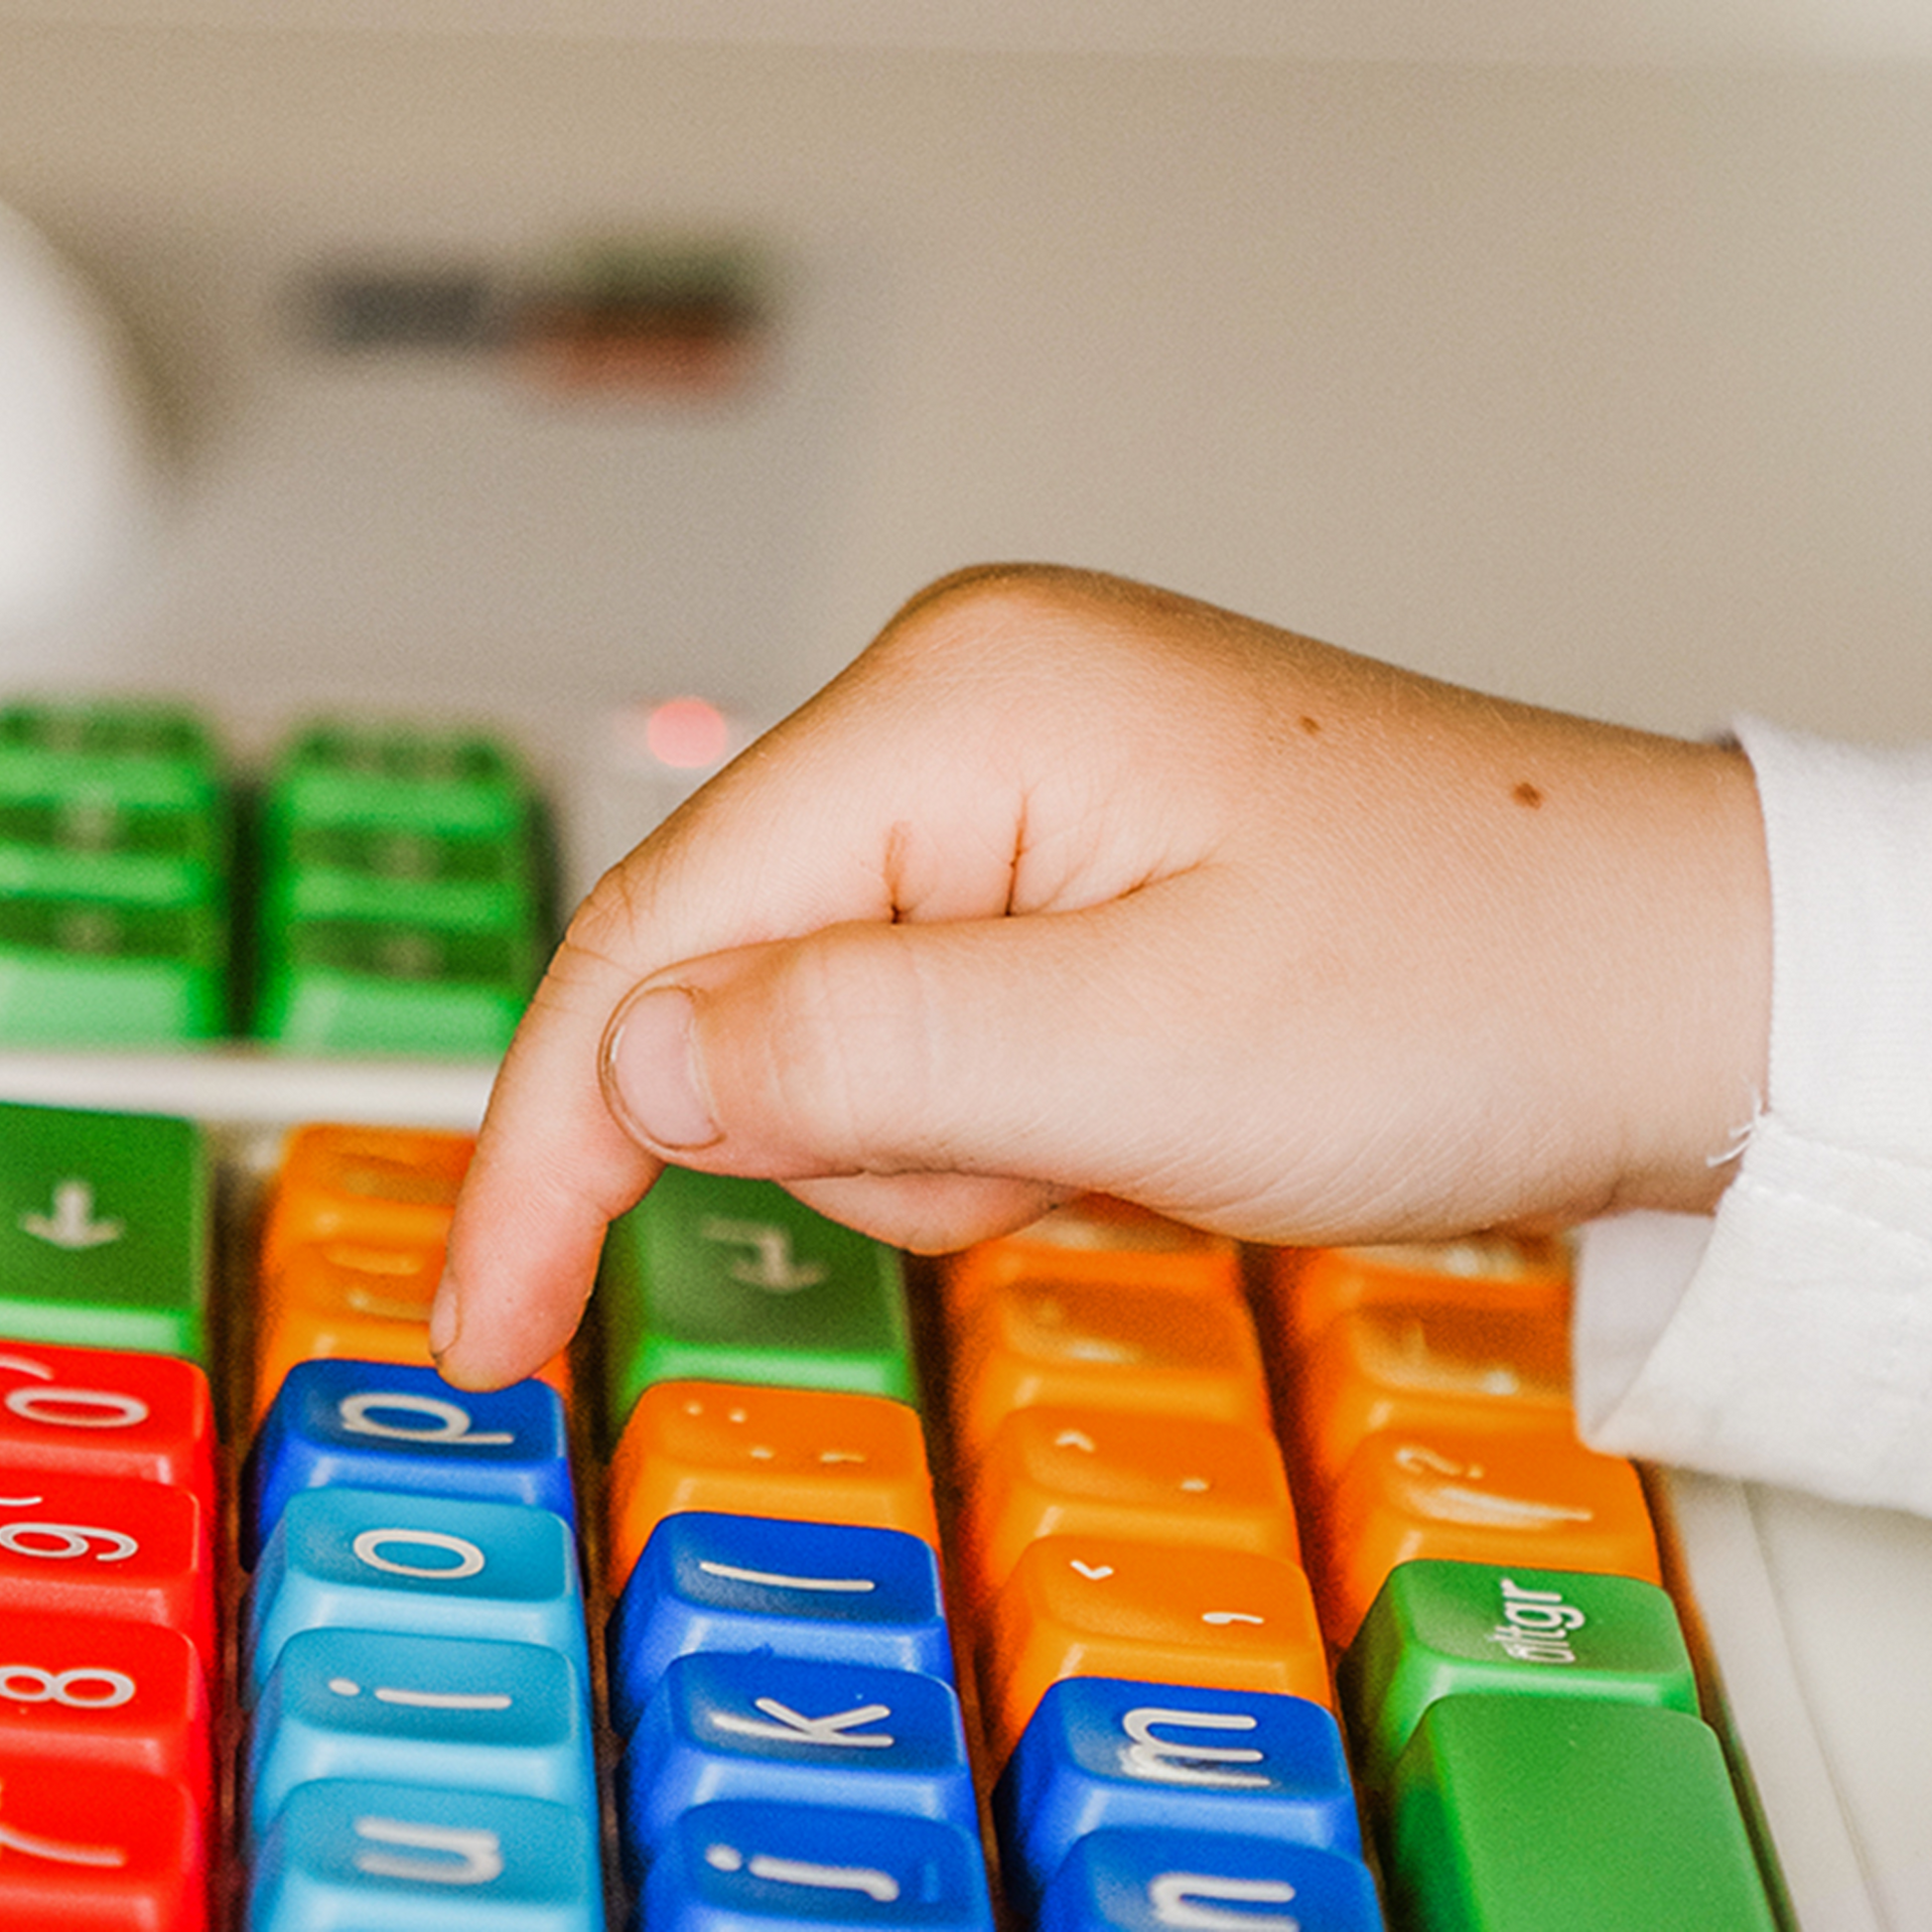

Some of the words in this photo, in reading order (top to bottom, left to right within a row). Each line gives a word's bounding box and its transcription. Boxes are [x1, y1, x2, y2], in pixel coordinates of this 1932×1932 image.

[5, 1388, 147, 1427] 0
[339, 1393, 514, 1445] p
[0, 1522, 138, 1561] 9
[352, 1527, 485, 1580] o
[0, 1665, 135, 1708] 8
[328, 1677, 512, 1710] i
[712, 1697, 895, 1747] k
[1122, 1707, 1273, 1788] m
[354, 1816, 502, 1883] u
[706, 1845, 898, 1902] j
[1148, 1871, 1300, 1932] n
